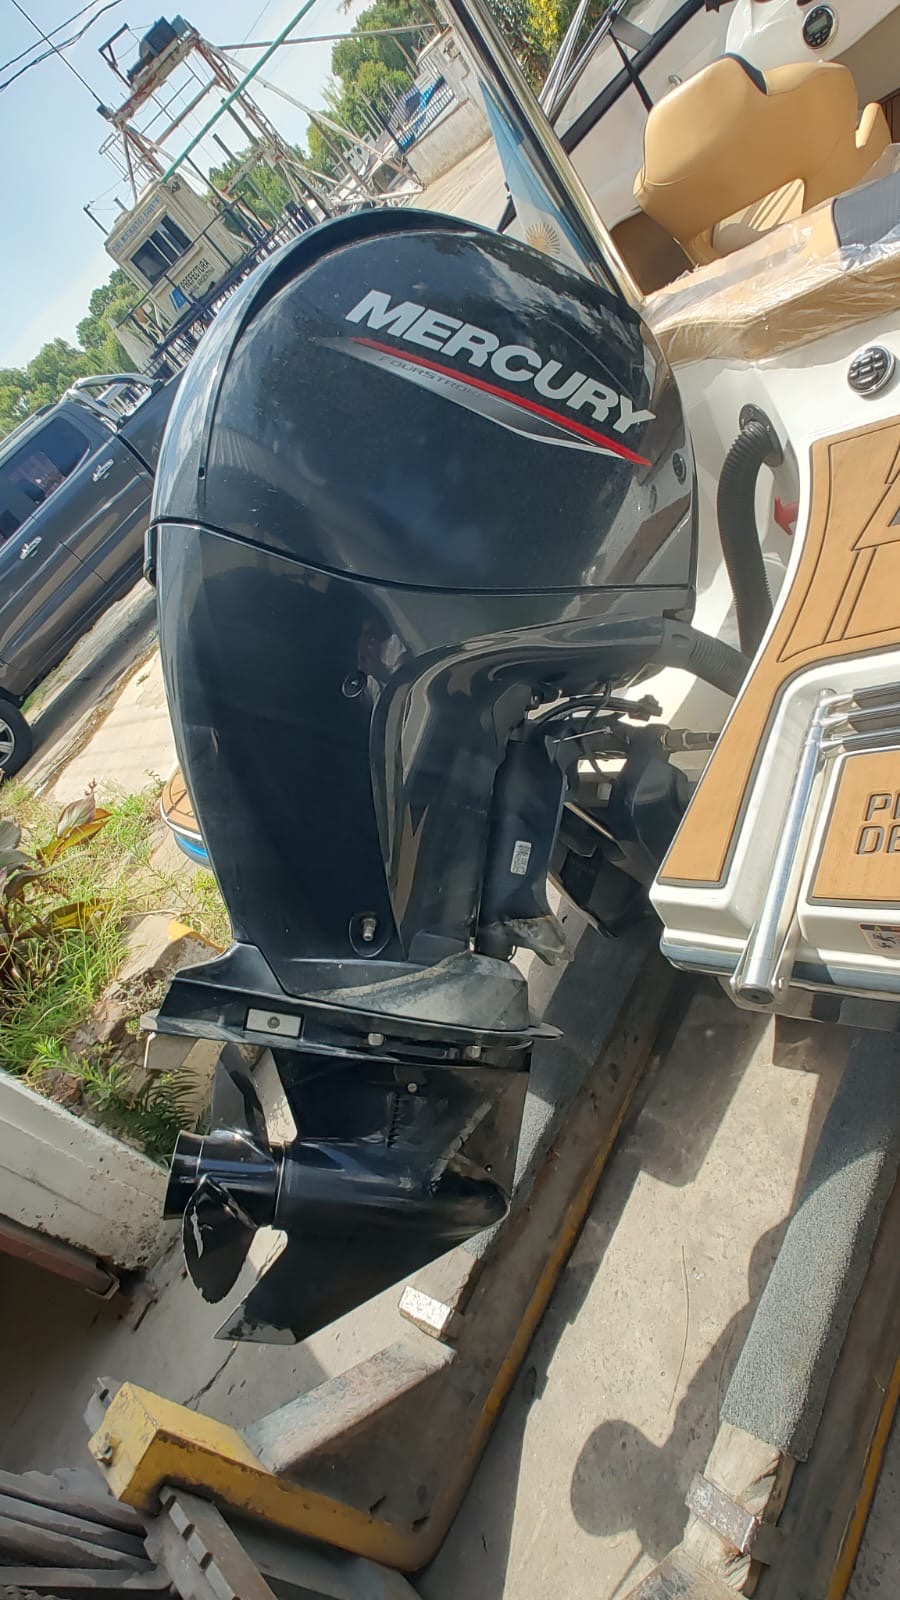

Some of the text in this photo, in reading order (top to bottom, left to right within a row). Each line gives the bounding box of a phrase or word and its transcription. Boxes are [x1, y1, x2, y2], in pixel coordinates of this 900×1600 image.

[180, 257, 210, 290] PREFECTURA
[345, 288, 656, 434] MERCURY
[378, 354, 486, 400] FOURSTROK
